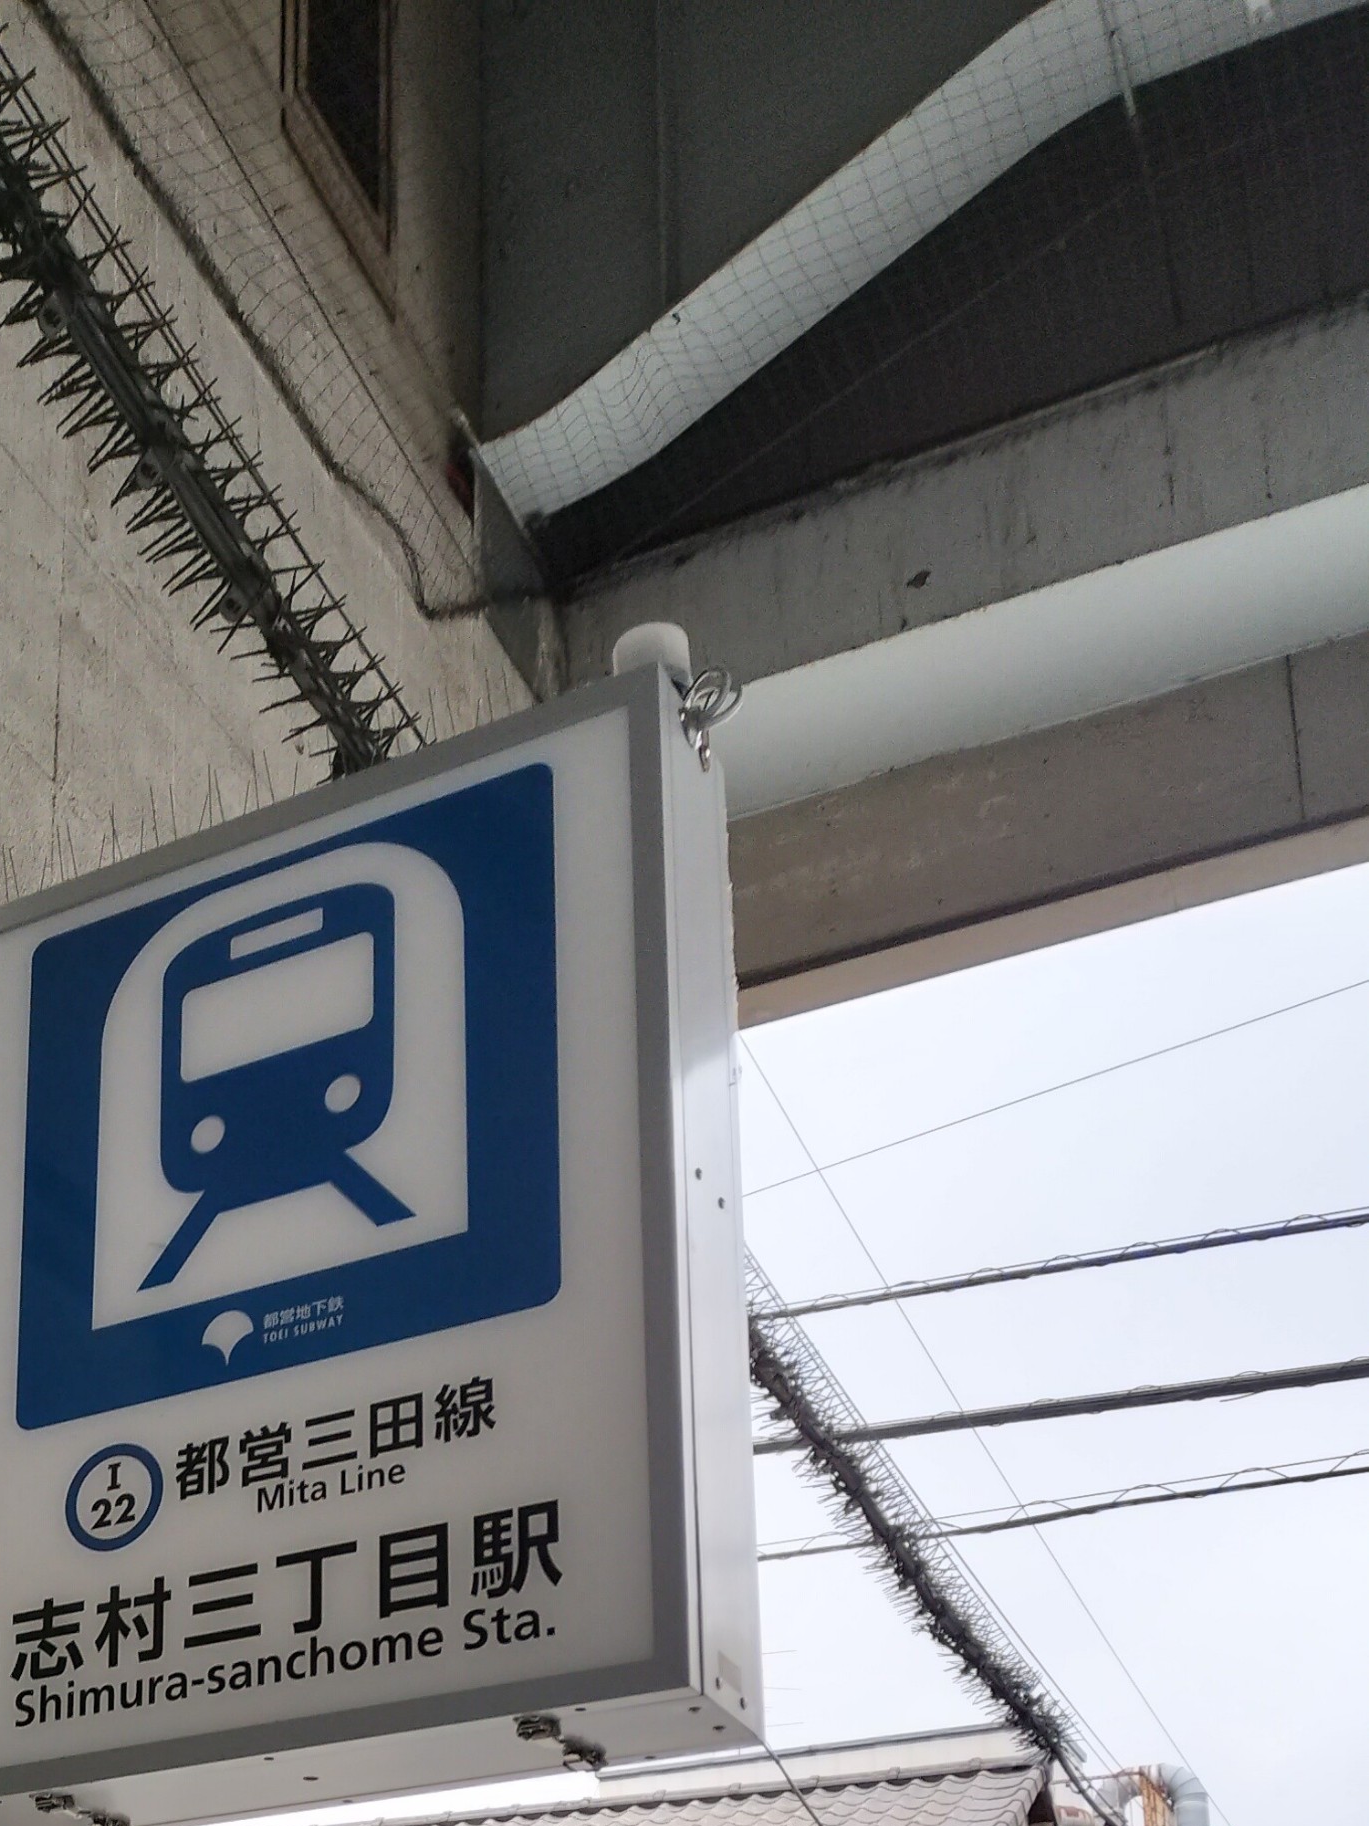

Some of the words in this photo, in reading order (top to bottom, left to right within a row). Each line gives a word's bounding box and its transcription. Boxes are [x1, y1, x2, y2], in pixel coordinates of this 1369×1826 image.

[263, 1296, 344, 1329] 都営地下鉄
[263, 1328, 288, 1344] TOEI
[293, 1314, 344, 1337] SUBWAY
[176, 1376, 497, 1501] 都営三田線
[90, 1495, 137, 1531] 22
[256, 1474, 329, 1514] Mita
[340, 1460, 407, 1496] Line
[10, 1499, 564, 1682] 志村三丁目駅
[14, 1624, 444, 1729] Shimura-sanchome
[463, 1607, 558, 1650] Sta.
